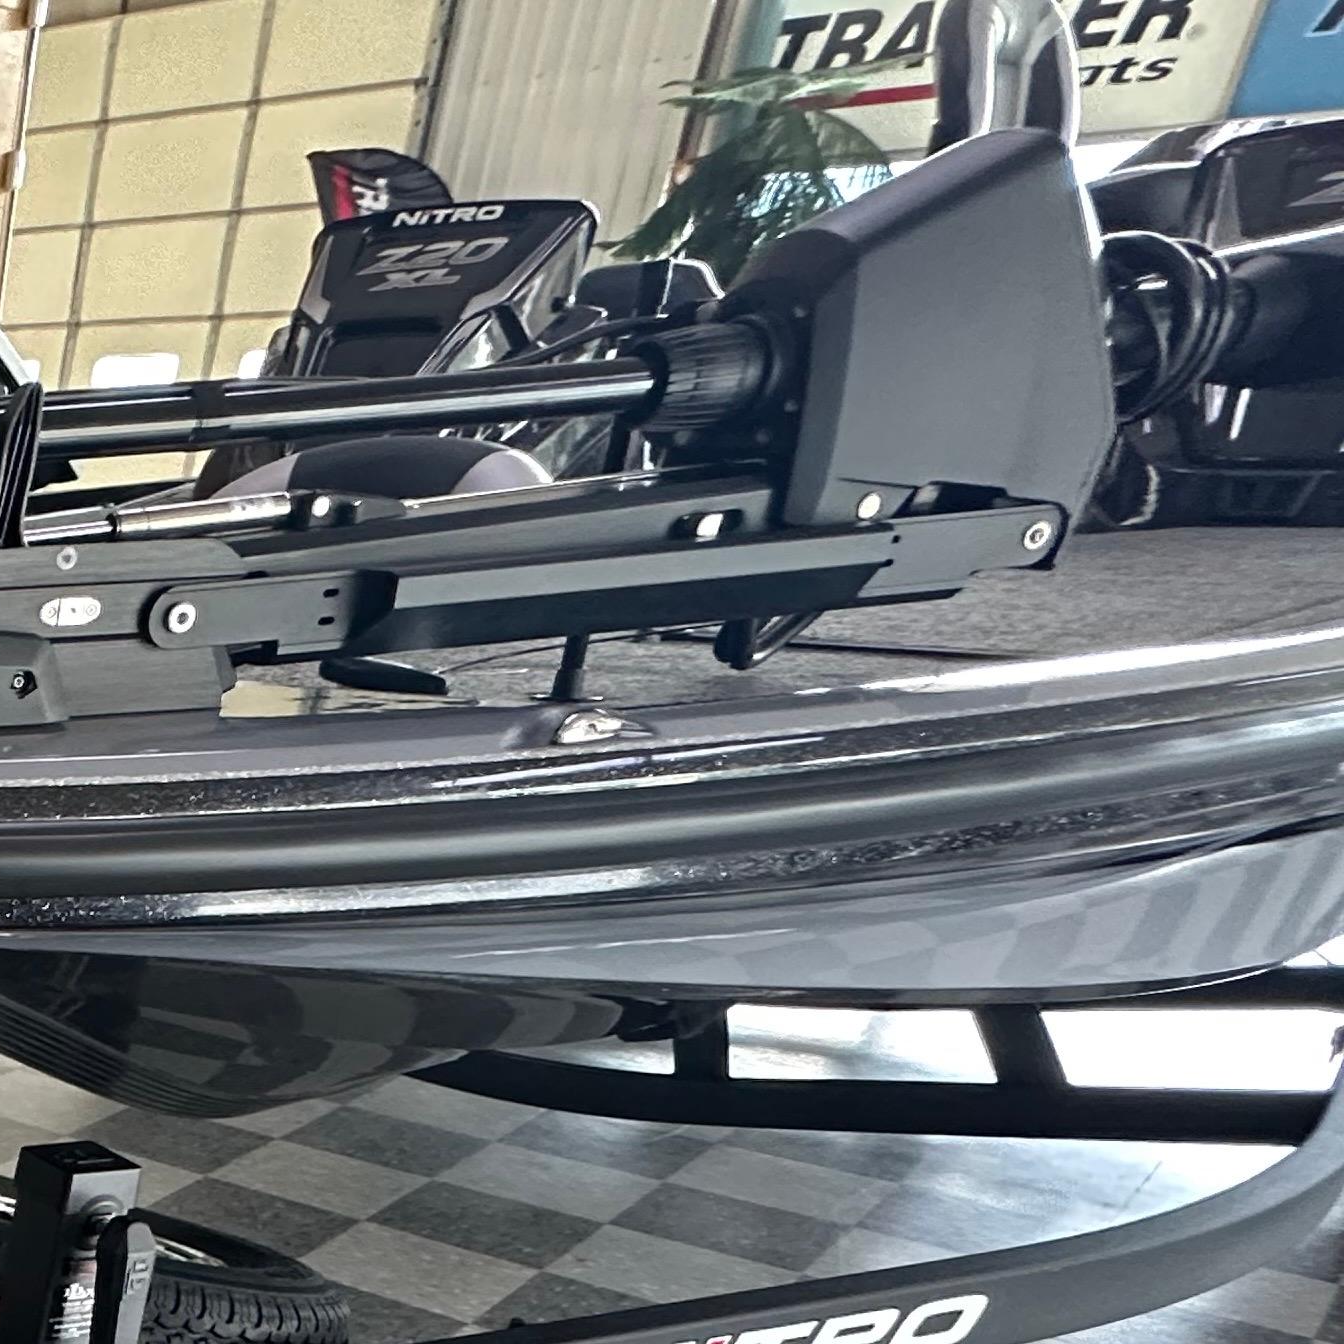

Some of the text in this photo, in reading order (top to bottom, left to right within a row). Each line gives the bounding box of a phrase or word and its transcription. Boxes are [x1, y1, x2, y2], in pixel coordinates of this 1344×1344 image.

[392, 205, 505, 227] NITRO
[356, 237, 509, 276] Z20
[368, 268, 461, 292] XL
